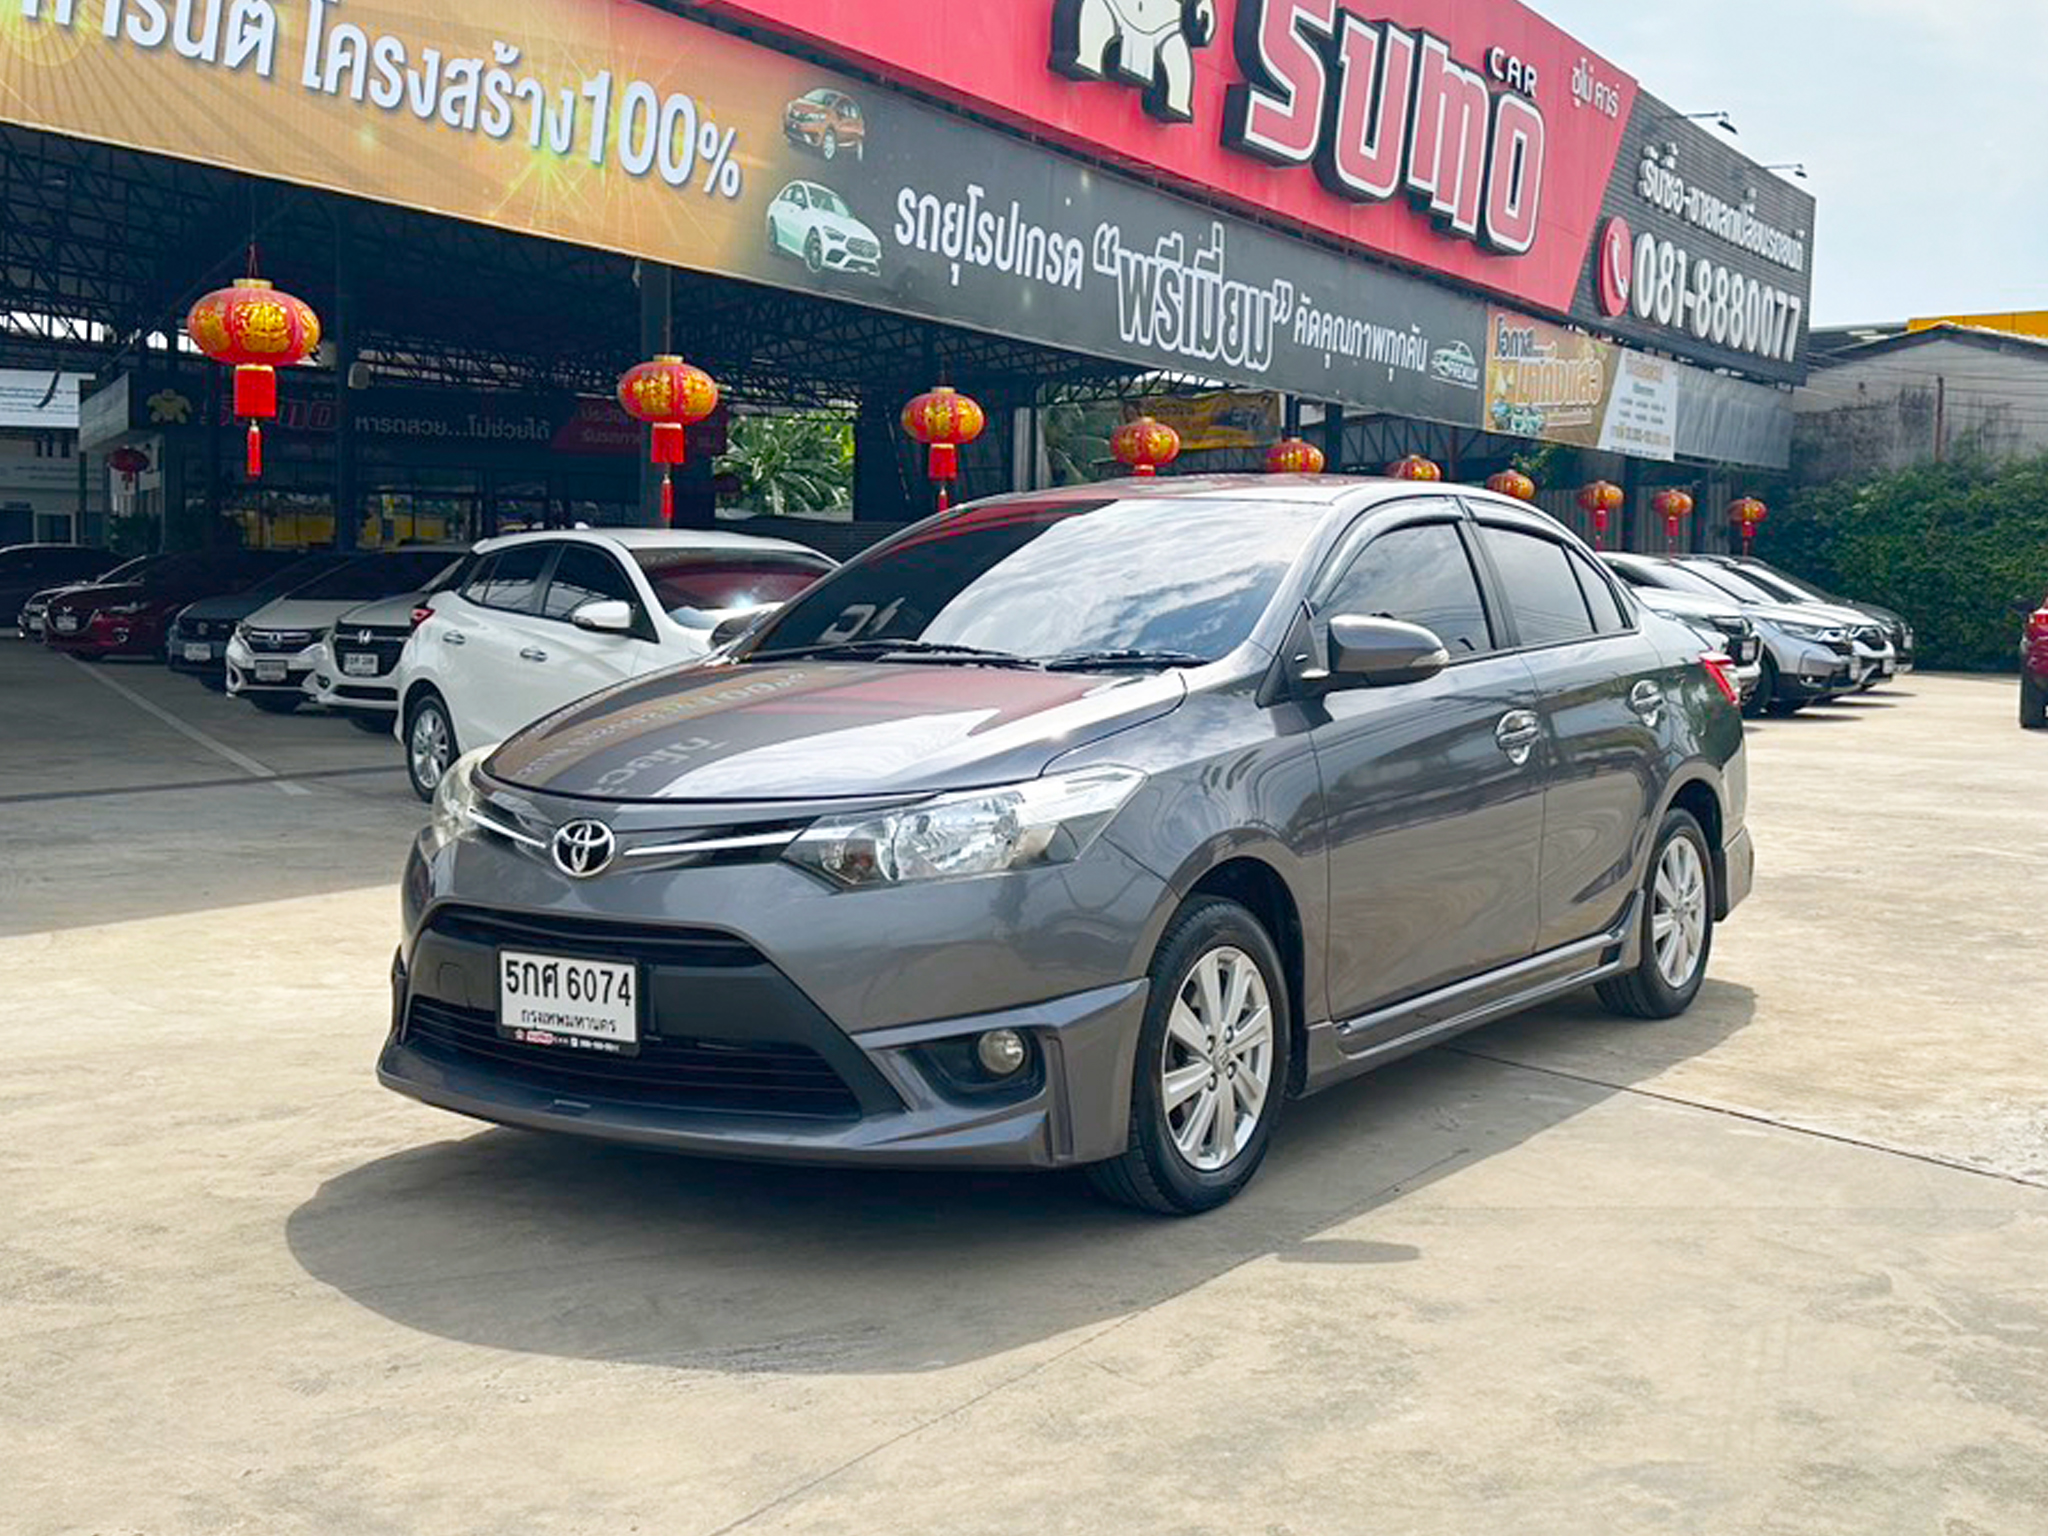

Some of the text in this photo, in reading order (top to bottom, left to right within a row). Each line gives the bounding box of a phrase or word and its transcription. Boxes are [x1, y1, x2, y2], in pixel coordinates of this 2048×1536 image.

[302, 0, 742, 199] โครงสร้าง100%
[1488, 45, 1538, 98] CAR
[895, 185, 1084, 290] รถยุโรปเกรด
[1294, 292, 1429, 382] คัดคุณภาพทุกคัน
[1633, 232, 1801, 362] 081-8880077
[505, 959, 632, 1007] 5กศ 6074
